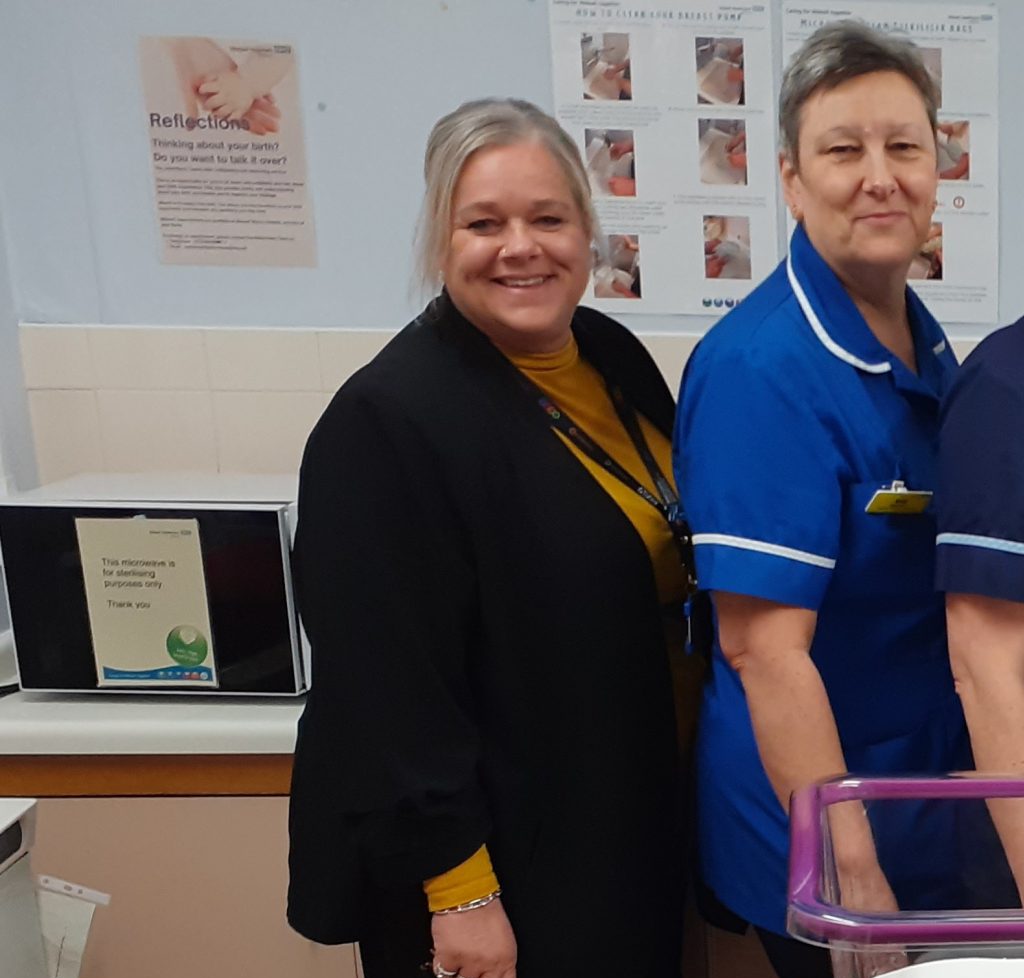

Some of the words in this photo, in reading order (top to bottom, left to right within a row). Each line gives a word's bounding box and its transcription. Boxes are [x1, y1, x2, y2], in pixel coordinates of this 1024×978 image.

[149, 112, 251, 131] Reflections
[152, 138, 194, 150] Thinking
[197, 140, 224, 149] about
[227, 142, 248, 151] your
[251, 142, 280, 151] birth?
[153, 152, 168, 162] Do
[170, 155, 188, 164] you
[191, 155, 214, 163] want
[217, 155, 228, 164] to
[230, 155, 248, 164] talk
[251, 156, 257, 164] it
[260, 156, 287, 165] over?
[102, 557, 120, 567] This
[121, 559, 167, 568] microwave
[168, 560, 176, 568] is
[102, 567, 114, 577] for
[104, 580, 143, 589] purposes
[144, 580, 163, 590] only
[107, 599, 133, 609] Thank
[134, 601, 151, 609] you
